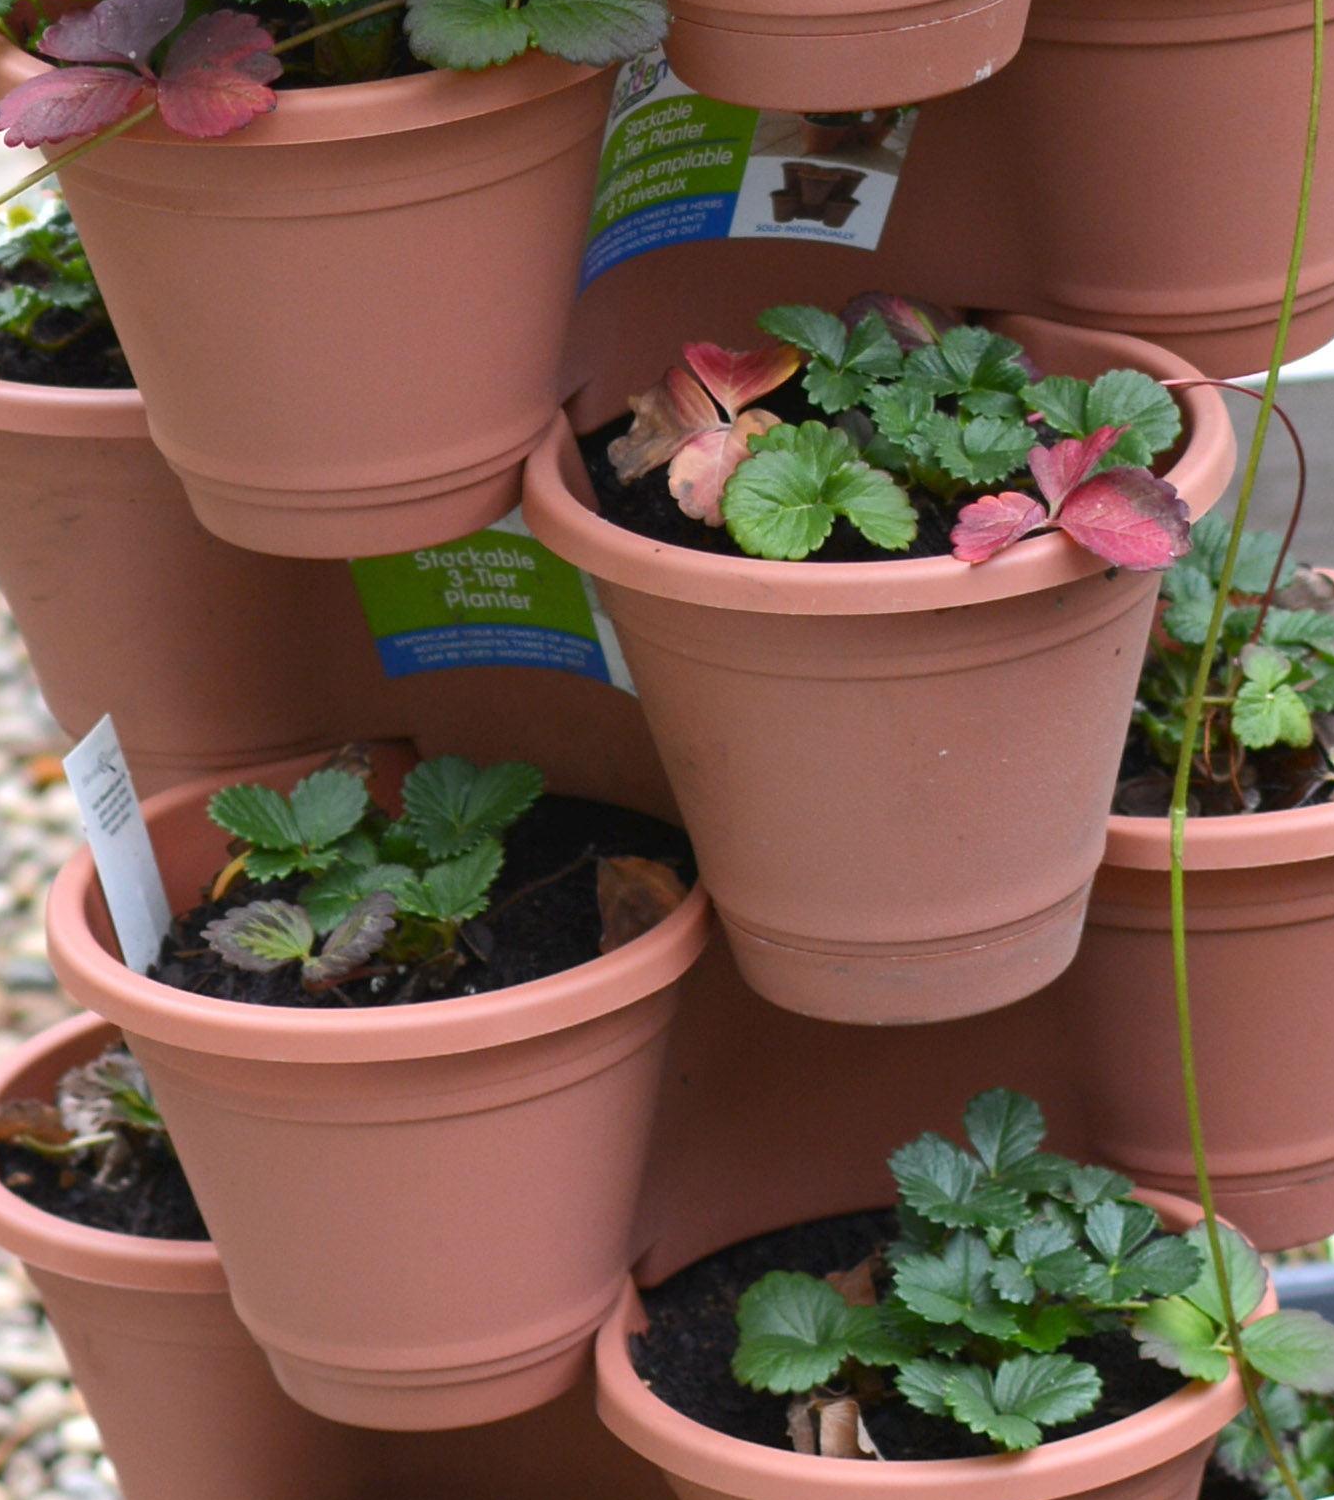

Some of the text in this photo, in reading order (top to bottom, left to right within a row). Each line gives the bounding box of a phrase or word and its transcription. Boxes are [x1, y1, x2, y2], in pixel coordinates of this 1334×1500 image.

[624, 100, 693, 140] Stackable
[648, 122, 707, 151] Planter
[646, 145, 733, 180] empilable
[628, 177, 688, 208] niveaux
[669, 211, 707, 225] PLANTS
[679, 222, 703, 235] OUT
[755, 223, 782, 233] SOLD
[413, 546, 536, 570] Stackable
[447, 568, 517, 588] 3-Tier
[443, 588, 531, 611] Planter
